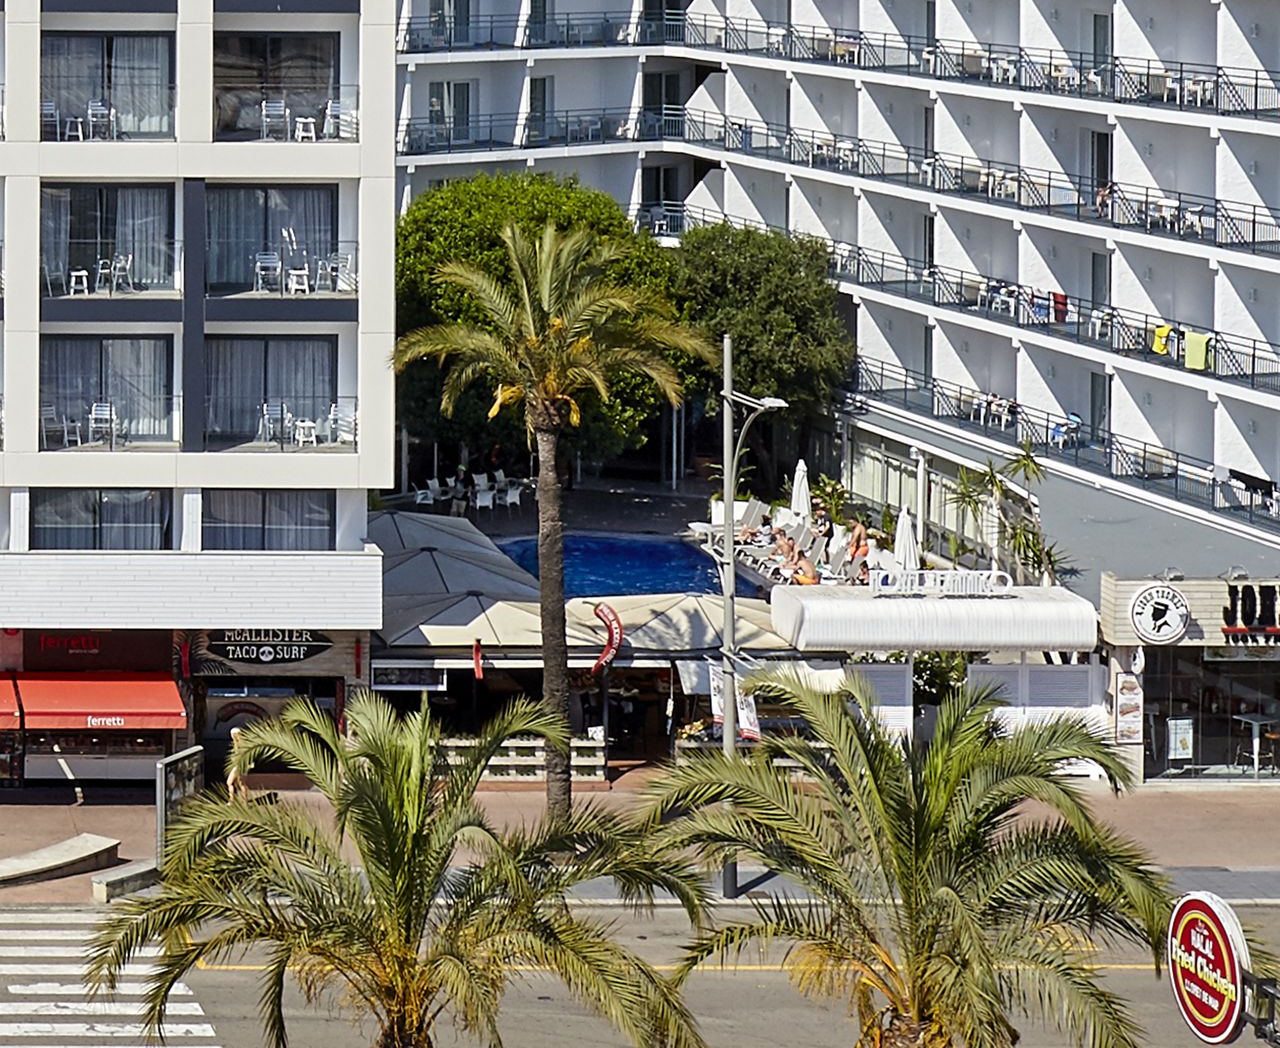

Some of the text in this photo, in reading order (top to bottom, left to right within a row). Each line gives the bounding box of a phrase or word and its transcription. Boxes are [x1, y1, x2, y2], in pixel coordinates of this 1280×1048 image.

[39, 632, 100, 650] ferretti
[225, 645, 308, 659] TACO SURF
[87, 715, 124, 728] ferretti
[1171, 936, 1236, 1002] Fried Chicken
